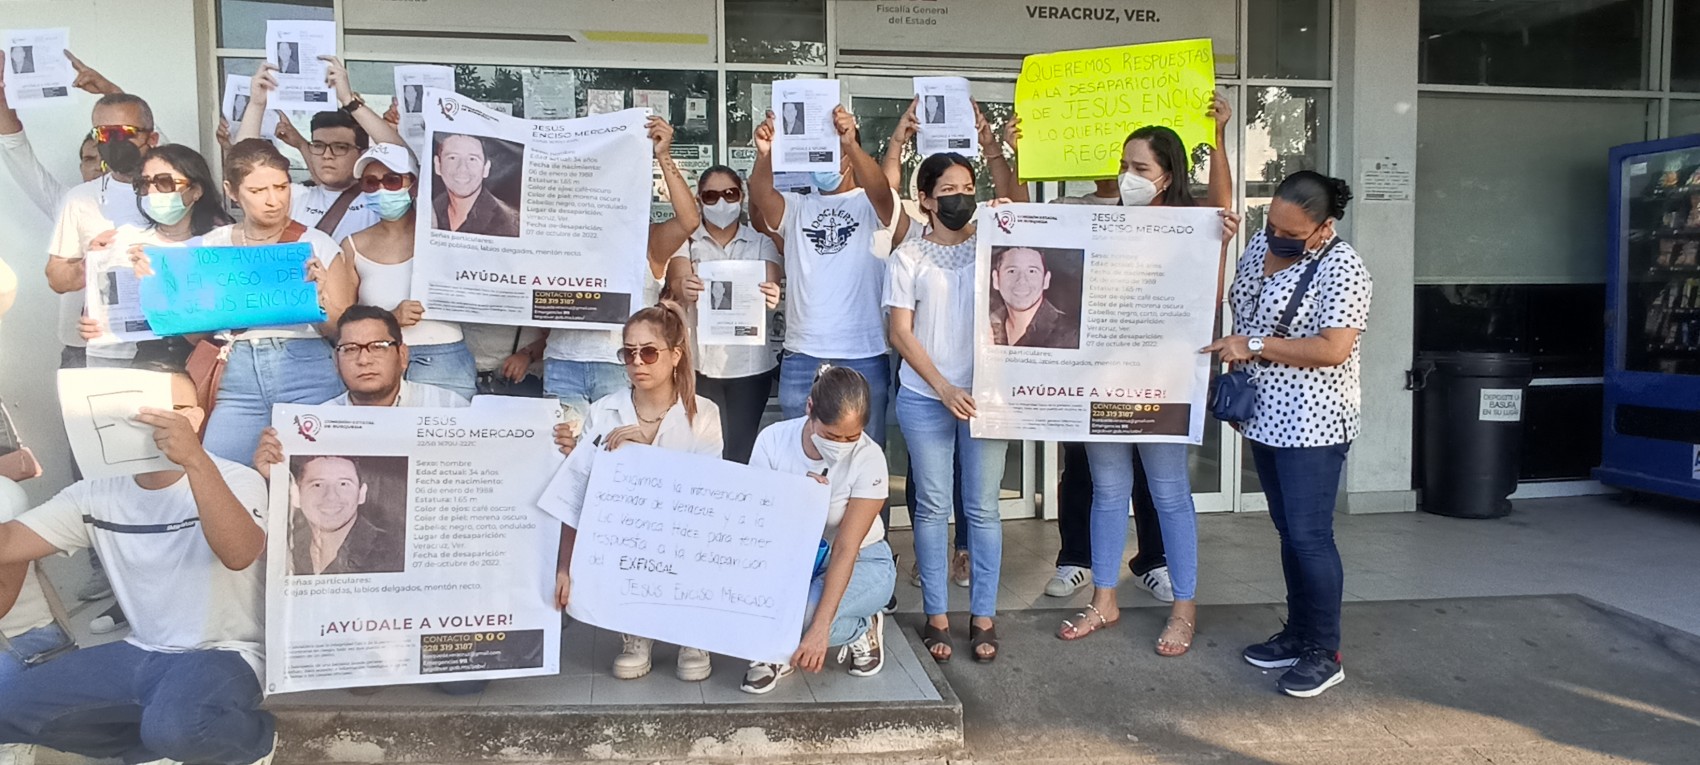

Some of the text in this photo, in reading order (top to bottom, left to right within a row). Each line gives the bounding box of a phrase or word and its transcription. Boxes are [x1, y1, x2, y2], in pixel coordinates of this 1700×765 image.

[876, 4, 948, 14] Fiscalía General
[1026, 6, 1160, 23] VERACRUZ, VER.
[888, 16, 936, 25] del Estado
[1026, 48, 1210, 83] QUEREMOS RESPUESTAS
[1034, 72, 1180, 100] A LA DESAPARICIÓN
[1032, 108, 1050, 120] DE
[1061, 94, 1130, 120] JESUS
[574, 125, 627, 137] MERCADO
[1039, 128, 1058, 142] LO
[1162, 115, 1184, 128] DE
[1064, 142, 1122, 164] REGR
[1092, 224, 1194, 234] ENCISO MERCADO
[232, 246, 306, 264] AVANCES
[216, 271, 262, 286] CASO
[456, 270, 608, 288] ¡AYÚDALE A VOLVER!
[246, 289, 309, 308] ENCISO
[1012, 384, 1084, 398] ¡AYÚDALE
[1090, 388, 1100, 398] A
[416, 428, 534, 438] ENCISO MERCADO
[414, 534, 438, 542] Lugar
[452, 532, 506, 542] desaparición:
[620, 556, 678, 575] EXFISCAL
[674, 583, 714, 601] ENCISO
[722, 586, 775, 608] MERCADO
[320, 614, 514, 636] ¡AYÚDALE A VOLVER!
[423, 634, 470, 643] CONTACTO
[423, 644, 438, 652] 228
[454, 642, 474, 650] 3187
